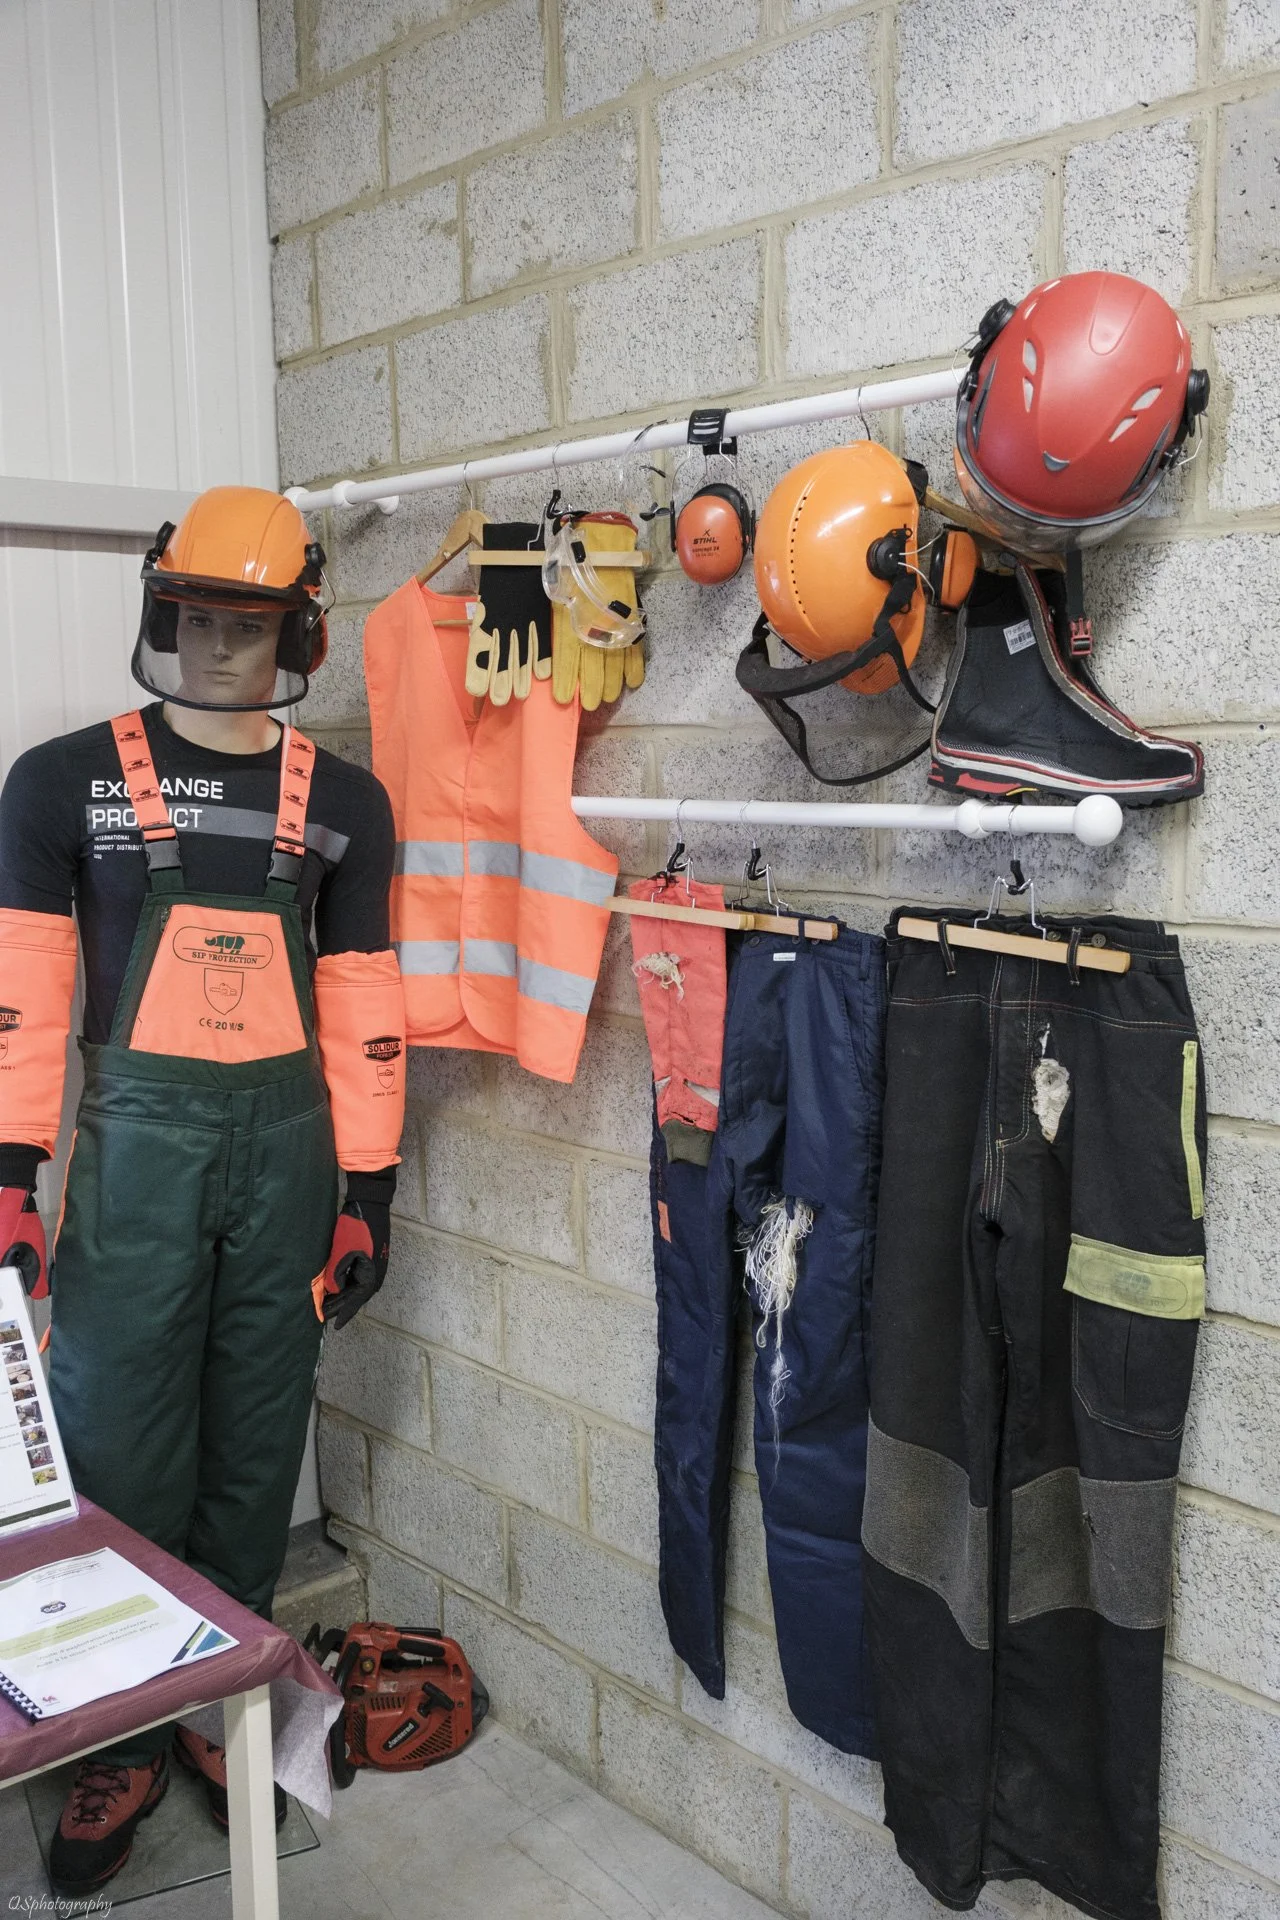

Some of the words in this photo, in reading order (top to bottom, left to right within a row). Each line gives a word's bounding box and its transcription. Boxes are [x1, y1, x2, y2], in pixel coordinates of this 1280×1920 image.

[91, 778, 223, 799] EXANGE
[92, 808, 203, 829] PROCT
[192, 951, 206, 959] SIP
[209, 953, 258, 964] PROTECTION
[368, 1042, 400, 1053] SOLIDUR
